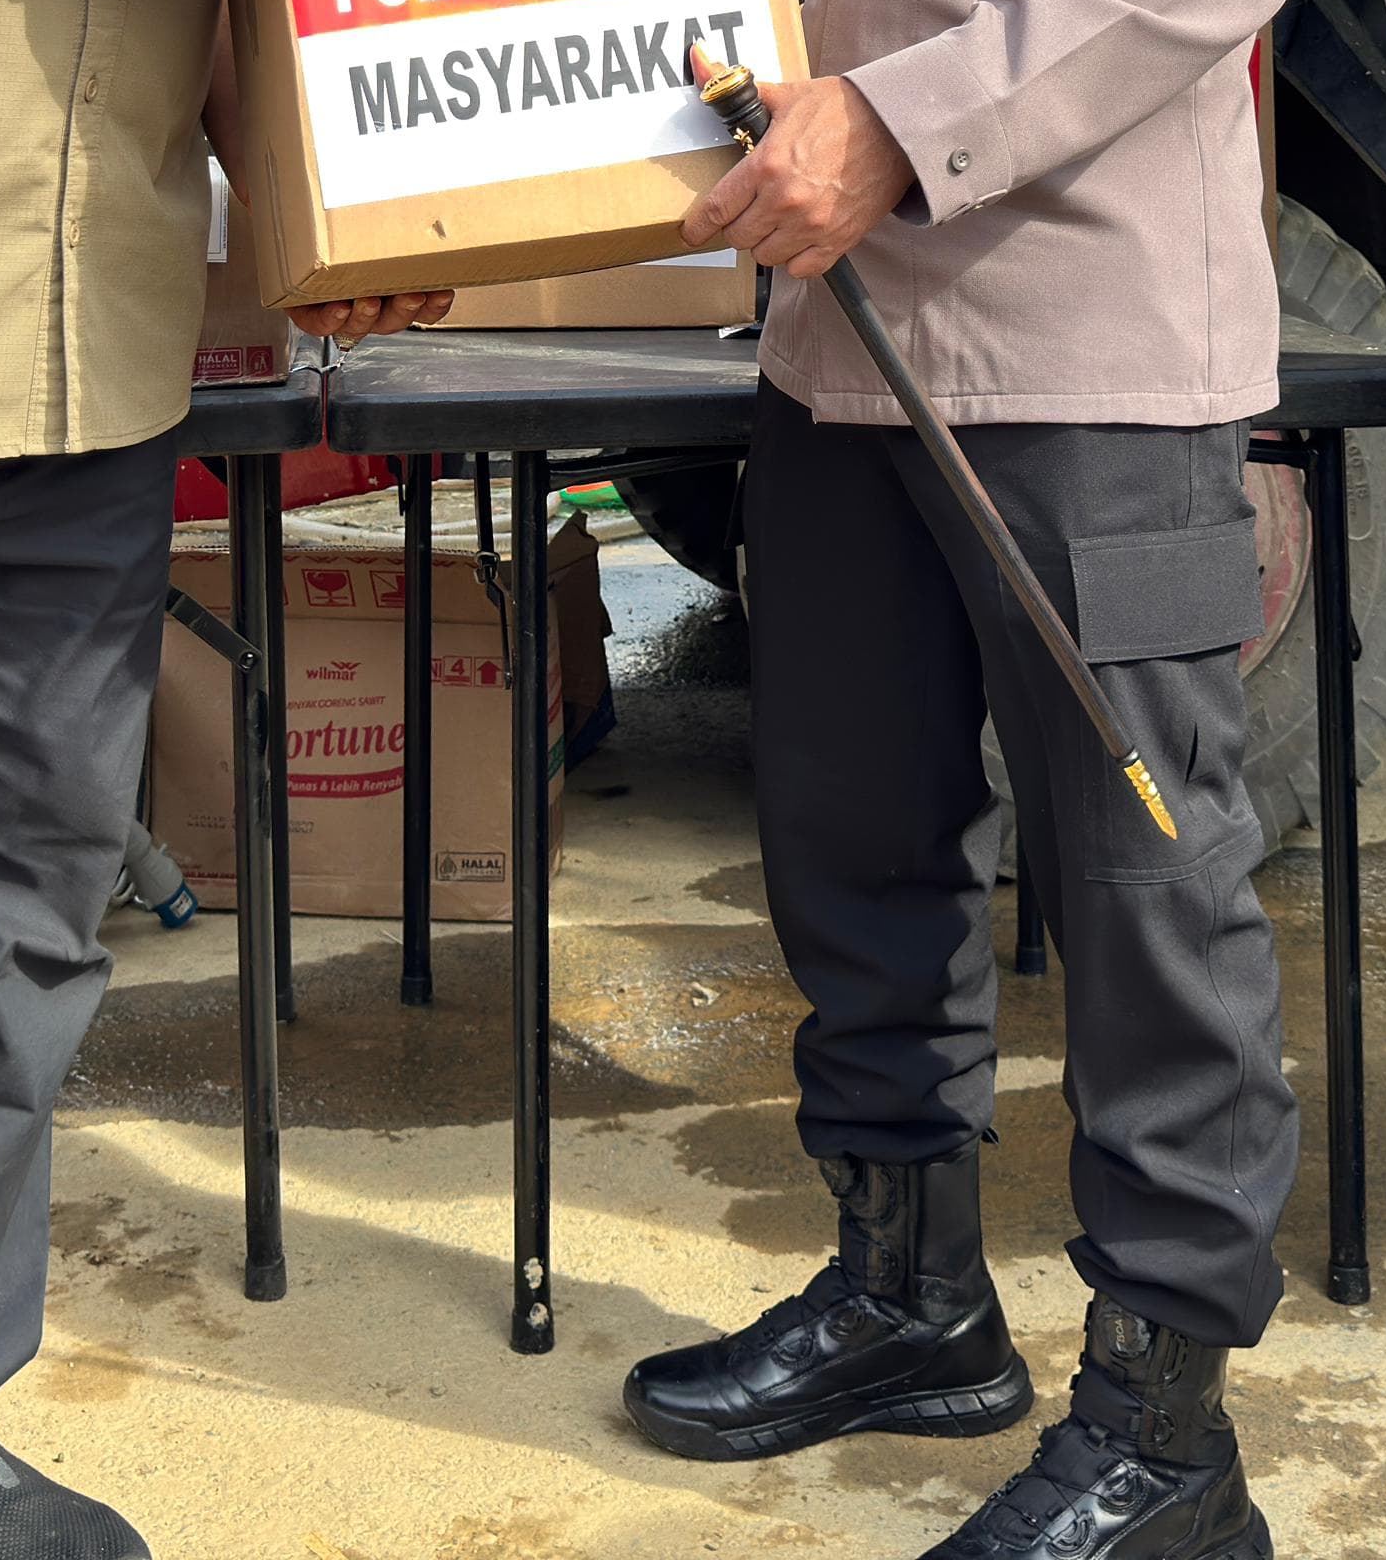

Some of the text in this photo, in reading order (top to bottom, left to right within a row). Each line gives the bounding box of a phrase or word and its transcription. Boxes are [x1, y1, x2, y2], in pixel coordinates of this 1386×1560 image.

[348, 10, 744, 135] MASYARAKAT
[198, 353, 237, 364] HALAL
[306, 666, 357, 681] wilmar
[331, 779, 360, 792] Lebih
[461, 858, 501, 869] HALAL
